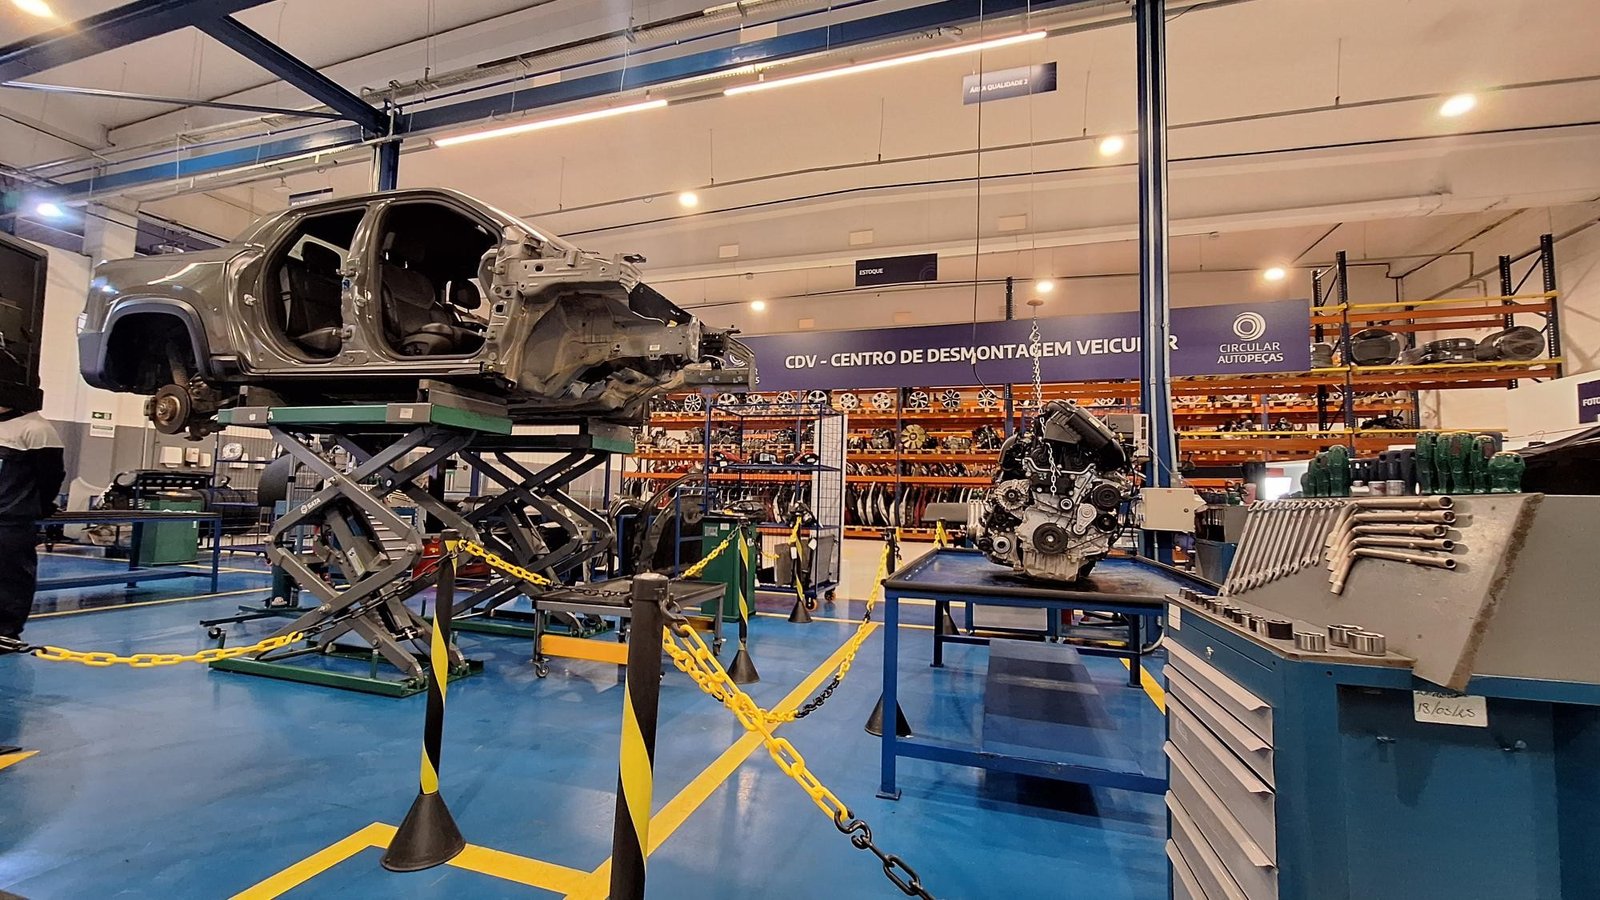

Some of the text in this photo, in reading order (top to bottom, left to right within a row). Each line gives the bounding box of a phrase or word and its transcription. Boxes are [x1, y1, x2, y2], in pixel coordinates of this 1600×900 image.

[987, 80, 1023, 90] QUALIDADE
[859, 268, 884, 276] ESTOQUE
[785, 354, 817, 369] CDV
[831, 350, 897, 367] CENTRO
[900, 349, 923, 364] DE
[927, 341, 1072, 362] DESMONTAGEM
[1076, 335, 1179, 355] VEICUR
[1219, 342, 1280, 352] CIRCULAR
[1217, 352, 1284, 364] AUTOPEÇAS
